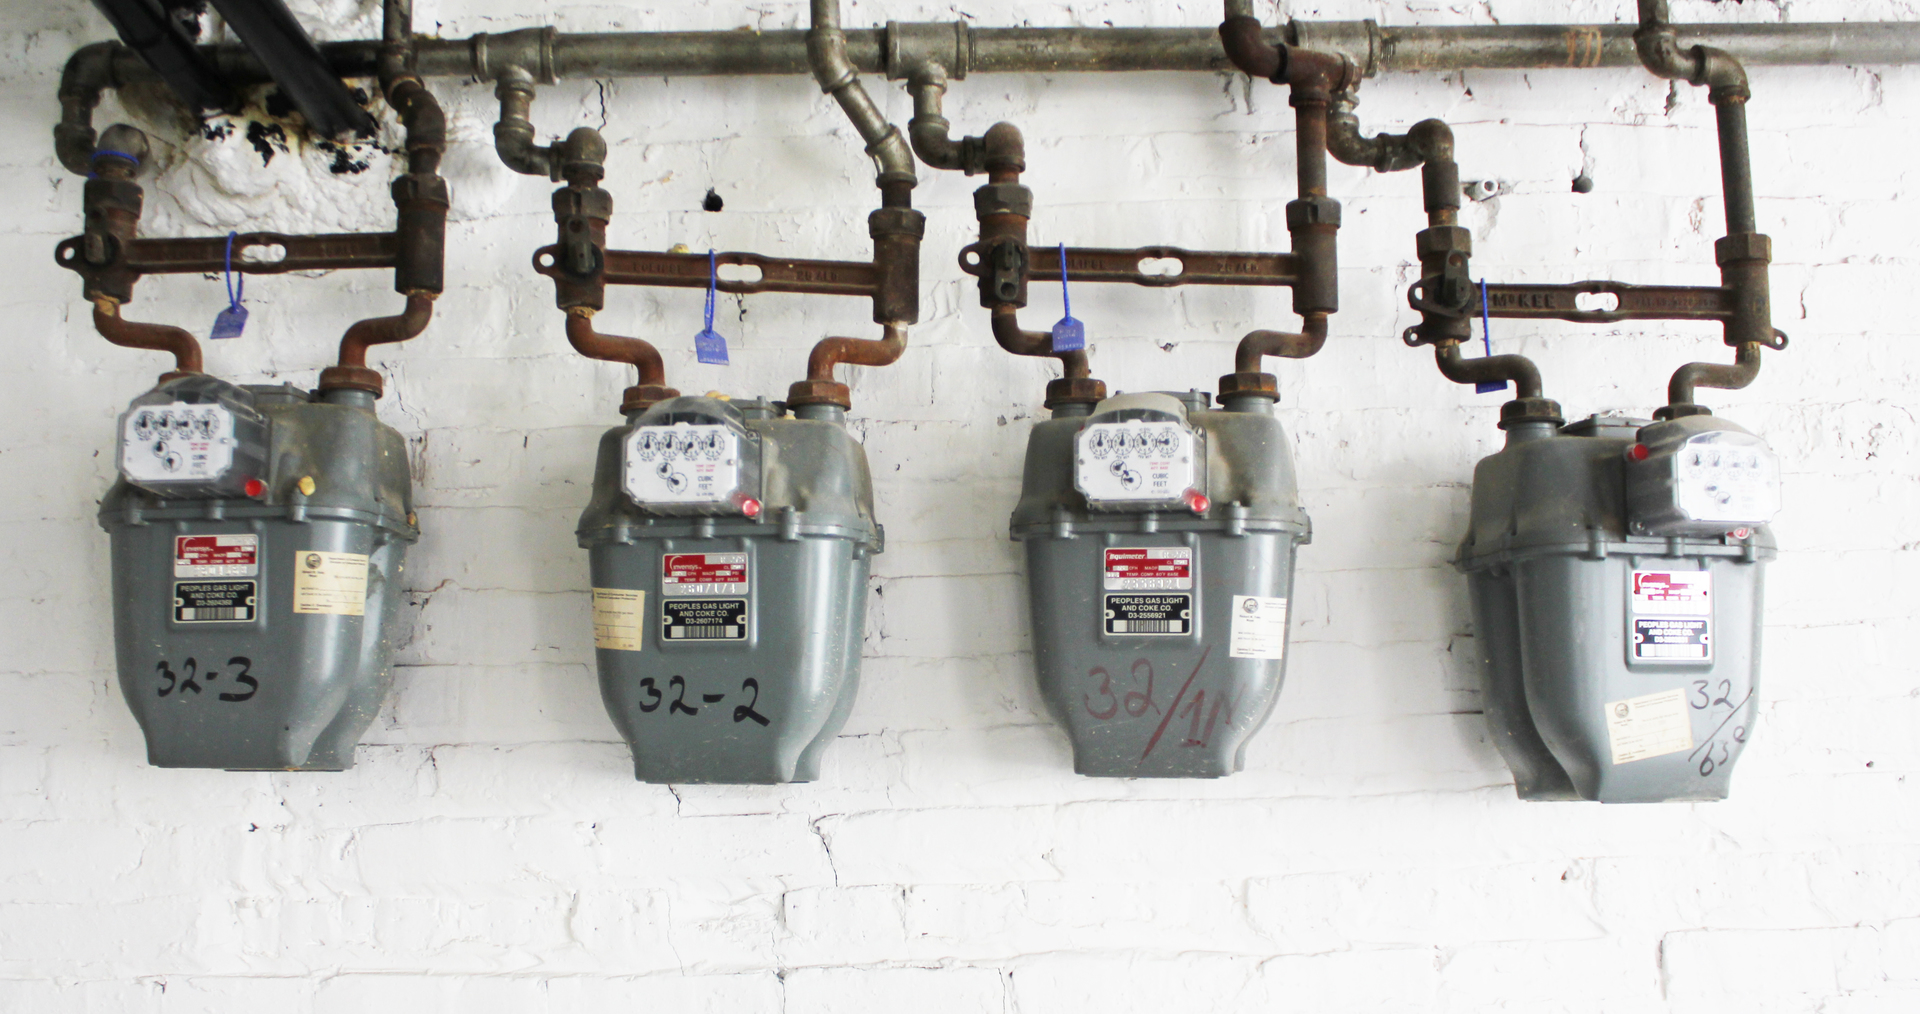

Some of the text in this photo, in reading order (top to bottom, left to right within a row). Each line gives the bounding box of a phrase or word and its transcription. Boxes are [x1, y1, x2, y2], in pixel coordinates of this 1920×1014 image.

[719, 602, 740, 610] LIGHT
[685, 617, 723, 625] D3-2607174
[1638, 621, 1669, 629] PEOPLES
[156, 656, 259, 702] 32-3
[639, 674, 771, 727] 32-2
